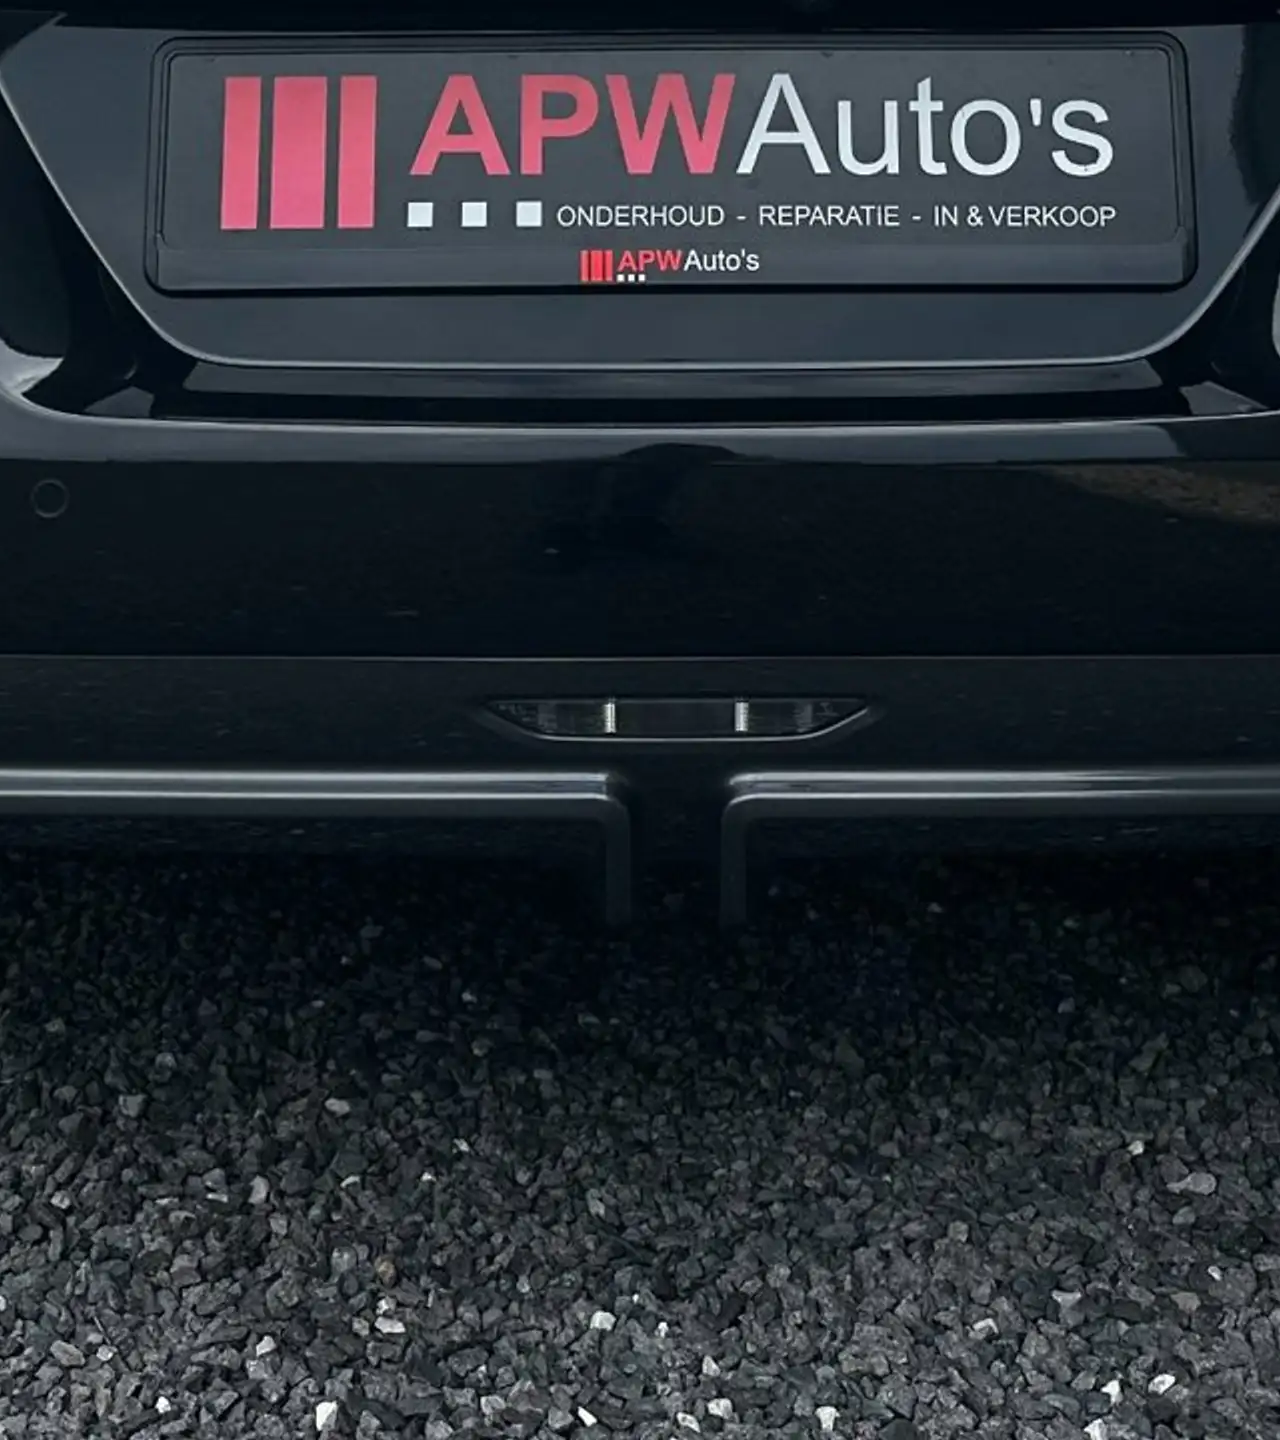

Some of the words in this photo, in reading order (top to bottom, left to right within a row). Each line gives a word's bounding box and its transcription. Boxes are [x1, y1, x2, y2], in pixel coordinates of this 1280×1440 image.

[556, 205, 725, 227] ONDERHOUD
[758, 205, 900, 227] REPARATIE
[934, 205, 958, 227] IN
[966, 205, 984, 227] &
[987, 205, 1117, 227] VERKOOP
